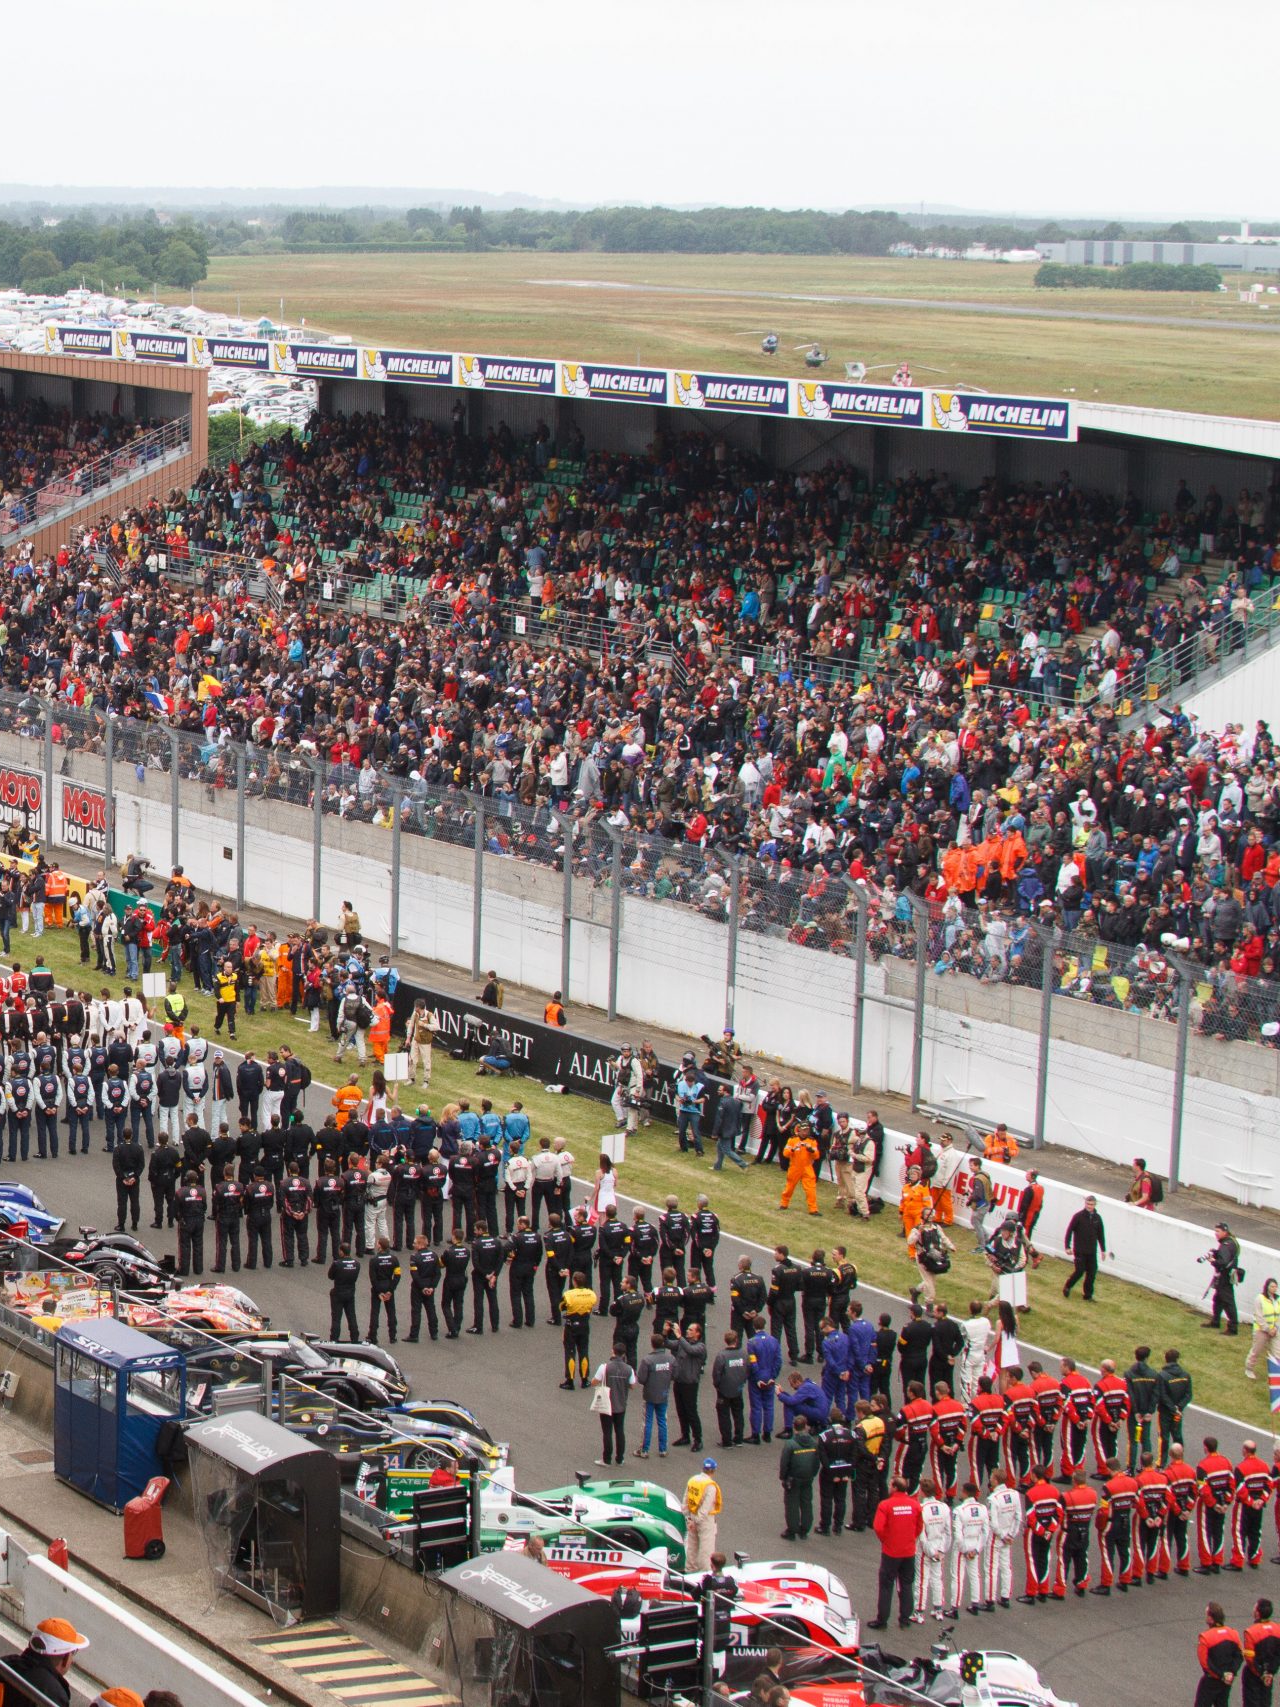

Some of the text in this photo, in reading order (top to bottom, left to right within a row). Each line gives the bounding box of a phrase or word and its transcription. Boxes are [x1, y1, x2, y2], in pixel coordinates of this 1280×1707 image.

[63, 333, 111, 348] MICHELIN
[136, 338, 186, 355] MICHELIN
[213, 344, 267, 362] MICHELIN
[297, 351, 355, 368] MICHELIN
[386, 357, 451, 375] MICHELIN
[485, 364, 553, 384] MICHELIN
[590, 373, 665, 394] MICHELIN
[705, 382, 786, 404] MICHELIN
[831, 392, 920, 416] MICHELIN
[968, 403, 1066, 427] MICHELIN
[73, 1336, 113, 1355] SRT
[132, 1355, 179, 1366] SRT
[223, 1425, 278, 1457] REBELLION
[551, 1547, 623, 1563] nismo
[484, 1569, 553, 1609] REBELLION
